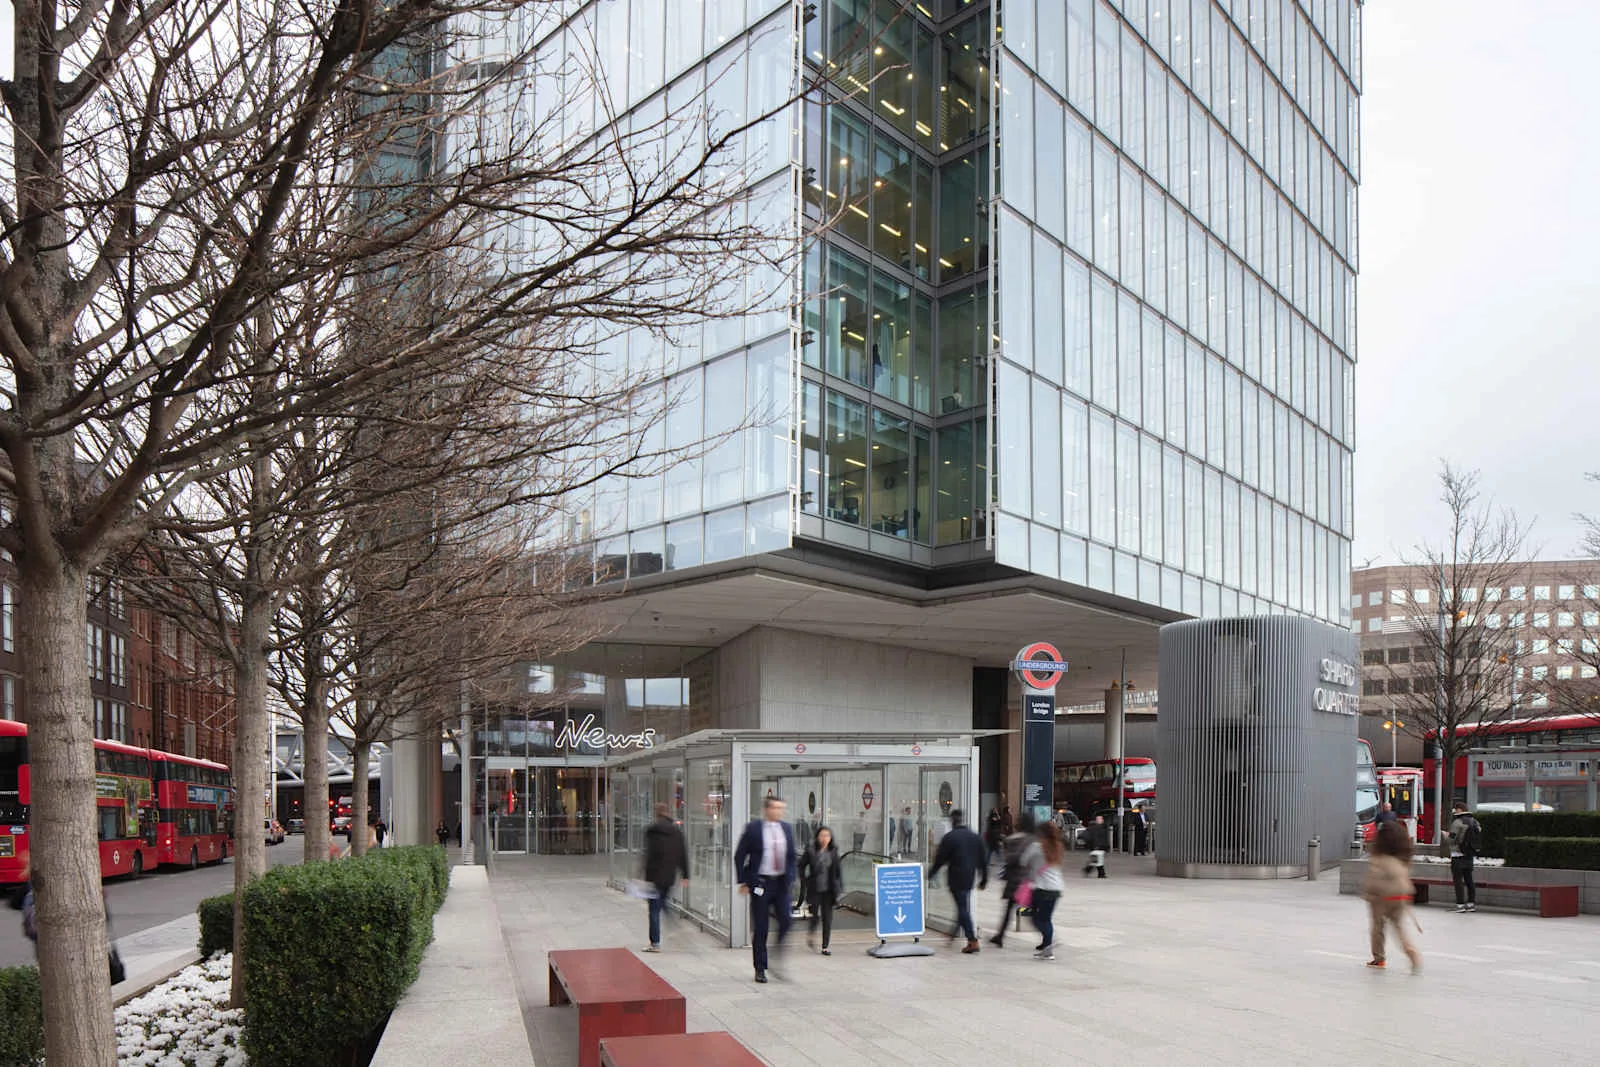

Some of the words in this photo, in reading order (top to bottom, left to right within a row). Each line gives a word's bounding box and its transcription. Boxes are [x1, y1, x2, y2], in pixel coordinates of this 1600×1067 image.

[1018, 661, 1066, 670] UNDERGROUND
[1320, 658, 1355, 687] SHARD
[1313, 687, 1360, 716] QUARTER
[554, 713, 656, 749] News
